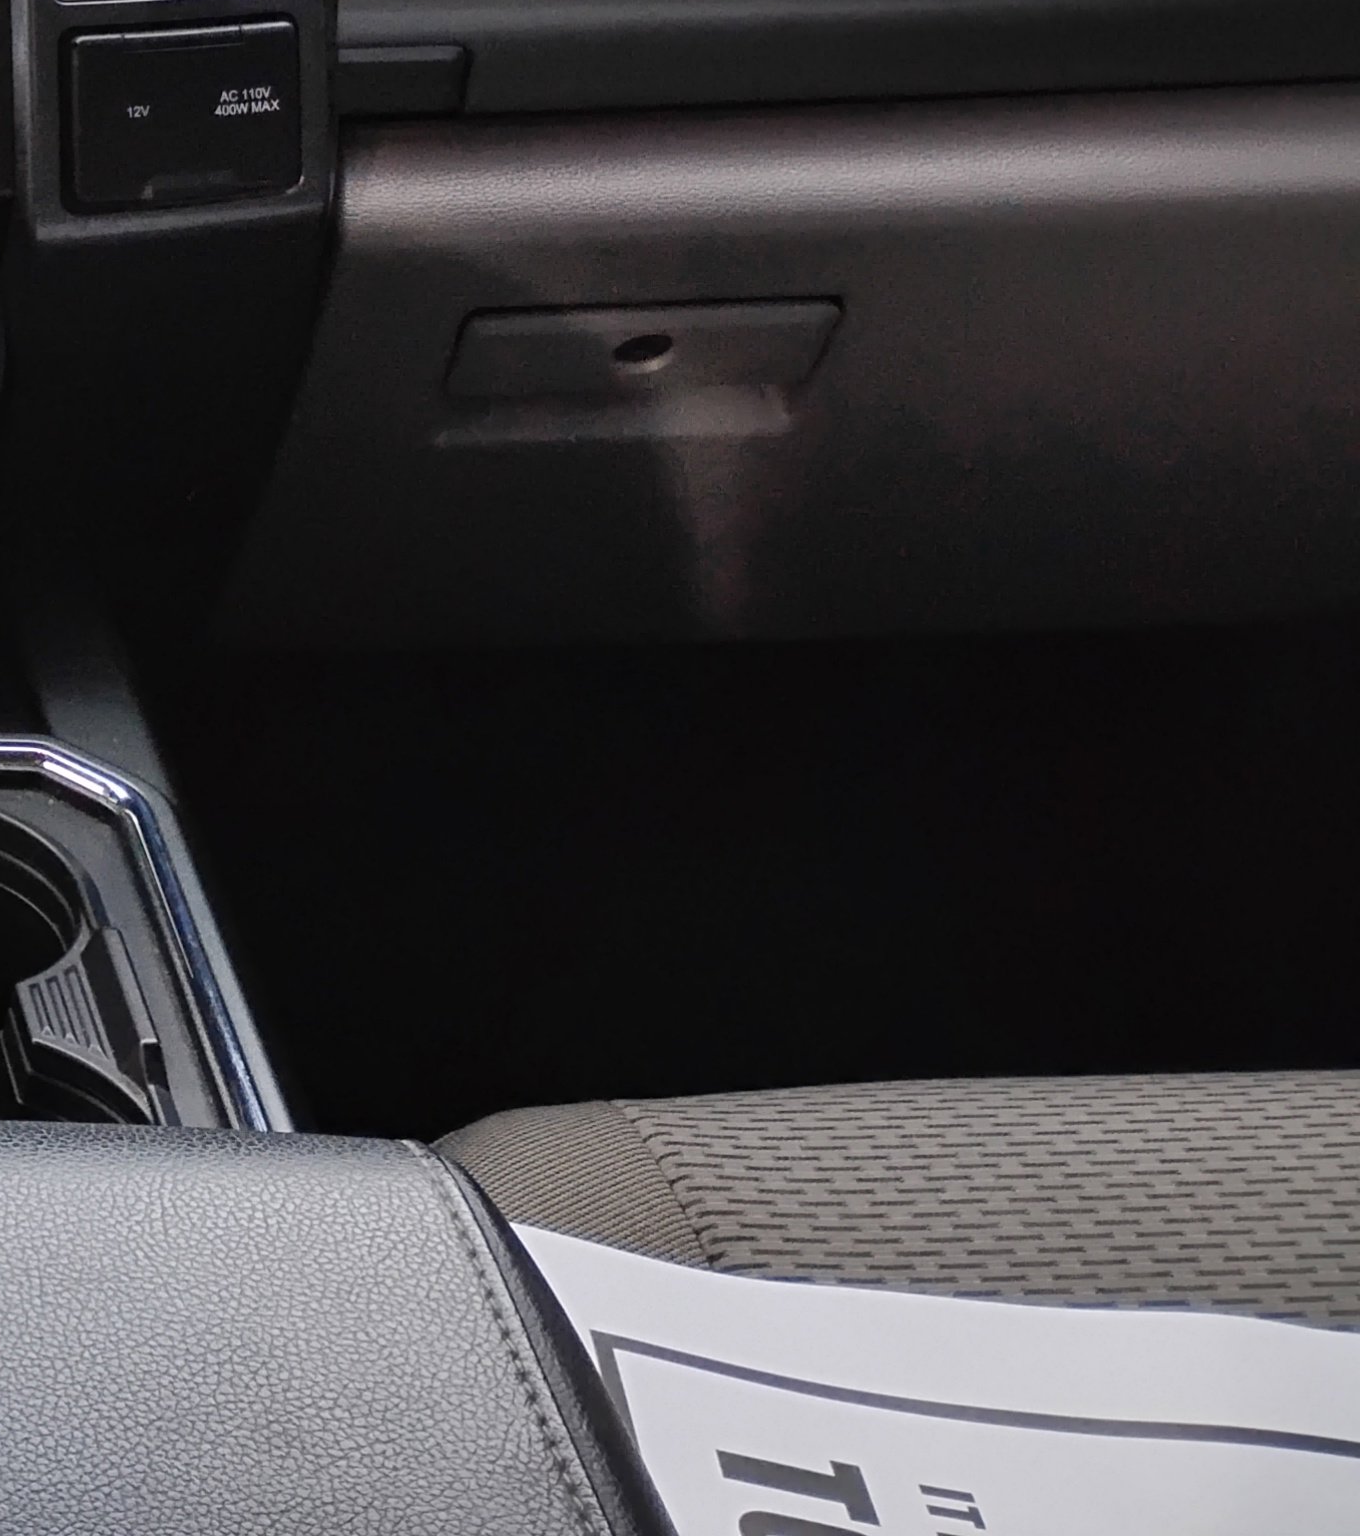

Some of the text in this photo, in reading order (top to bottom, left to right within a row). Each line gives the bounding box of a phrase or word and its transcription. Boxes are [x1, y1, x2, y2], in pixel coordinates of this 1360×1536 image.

[219, 86, 272, 103] AC 110V
[126, 105, 151, 119] 12V
[213, 98, 281, 117] 400W MAX
